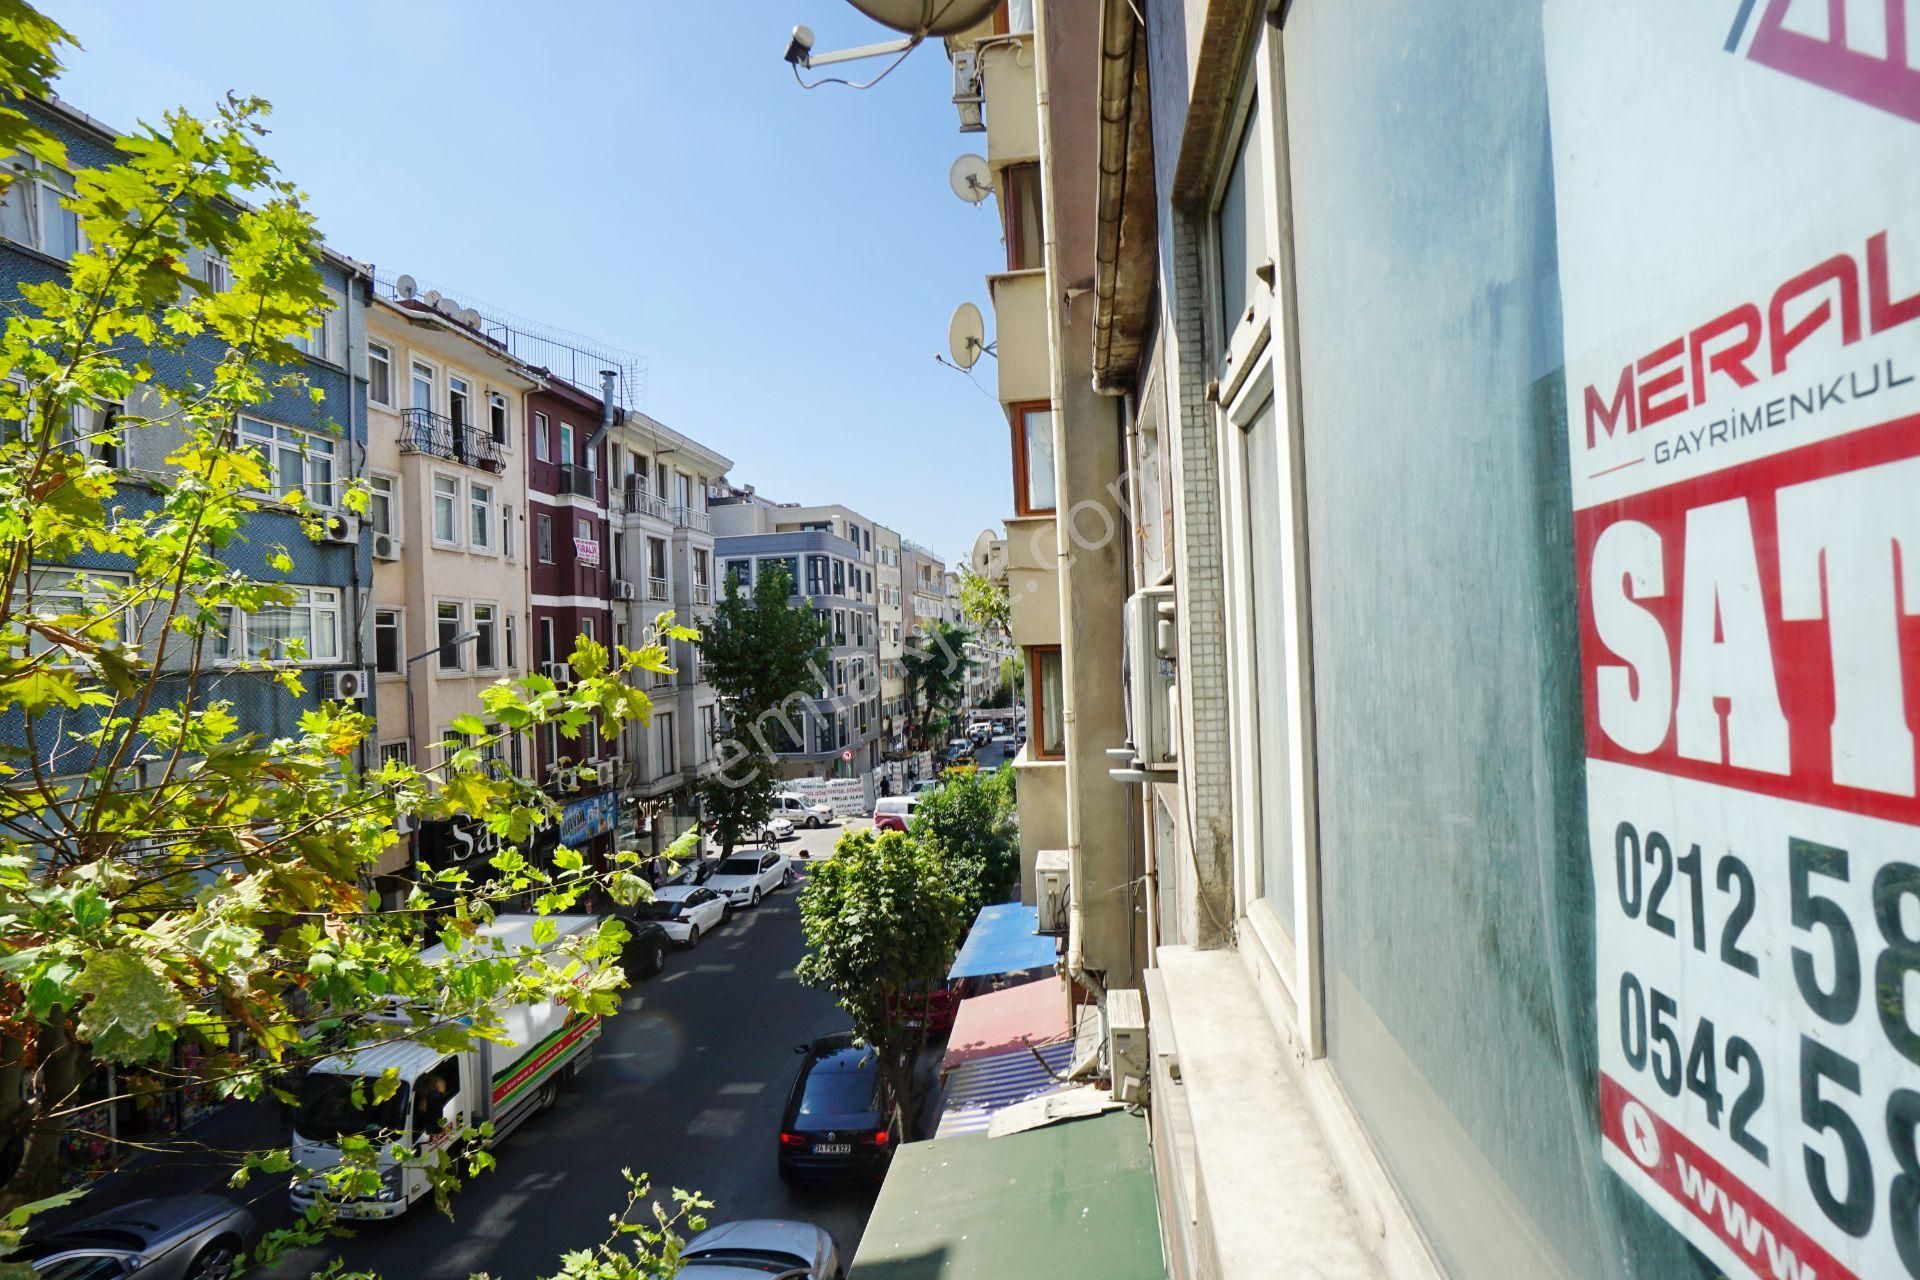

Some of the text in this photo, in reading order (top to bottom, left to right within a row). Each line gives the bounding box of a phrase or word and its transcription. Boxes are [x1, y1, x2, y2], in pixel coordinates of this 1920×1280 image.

[1584, 229, 1920, 450] MERAL
[1653, 358, 1915, 465] GAYRİMENKUL
[1591, 455, 1920, 798] SAT
[1615, 820, 1760, 979] 0212
[1619, 971, 1770, 1168] 0542
